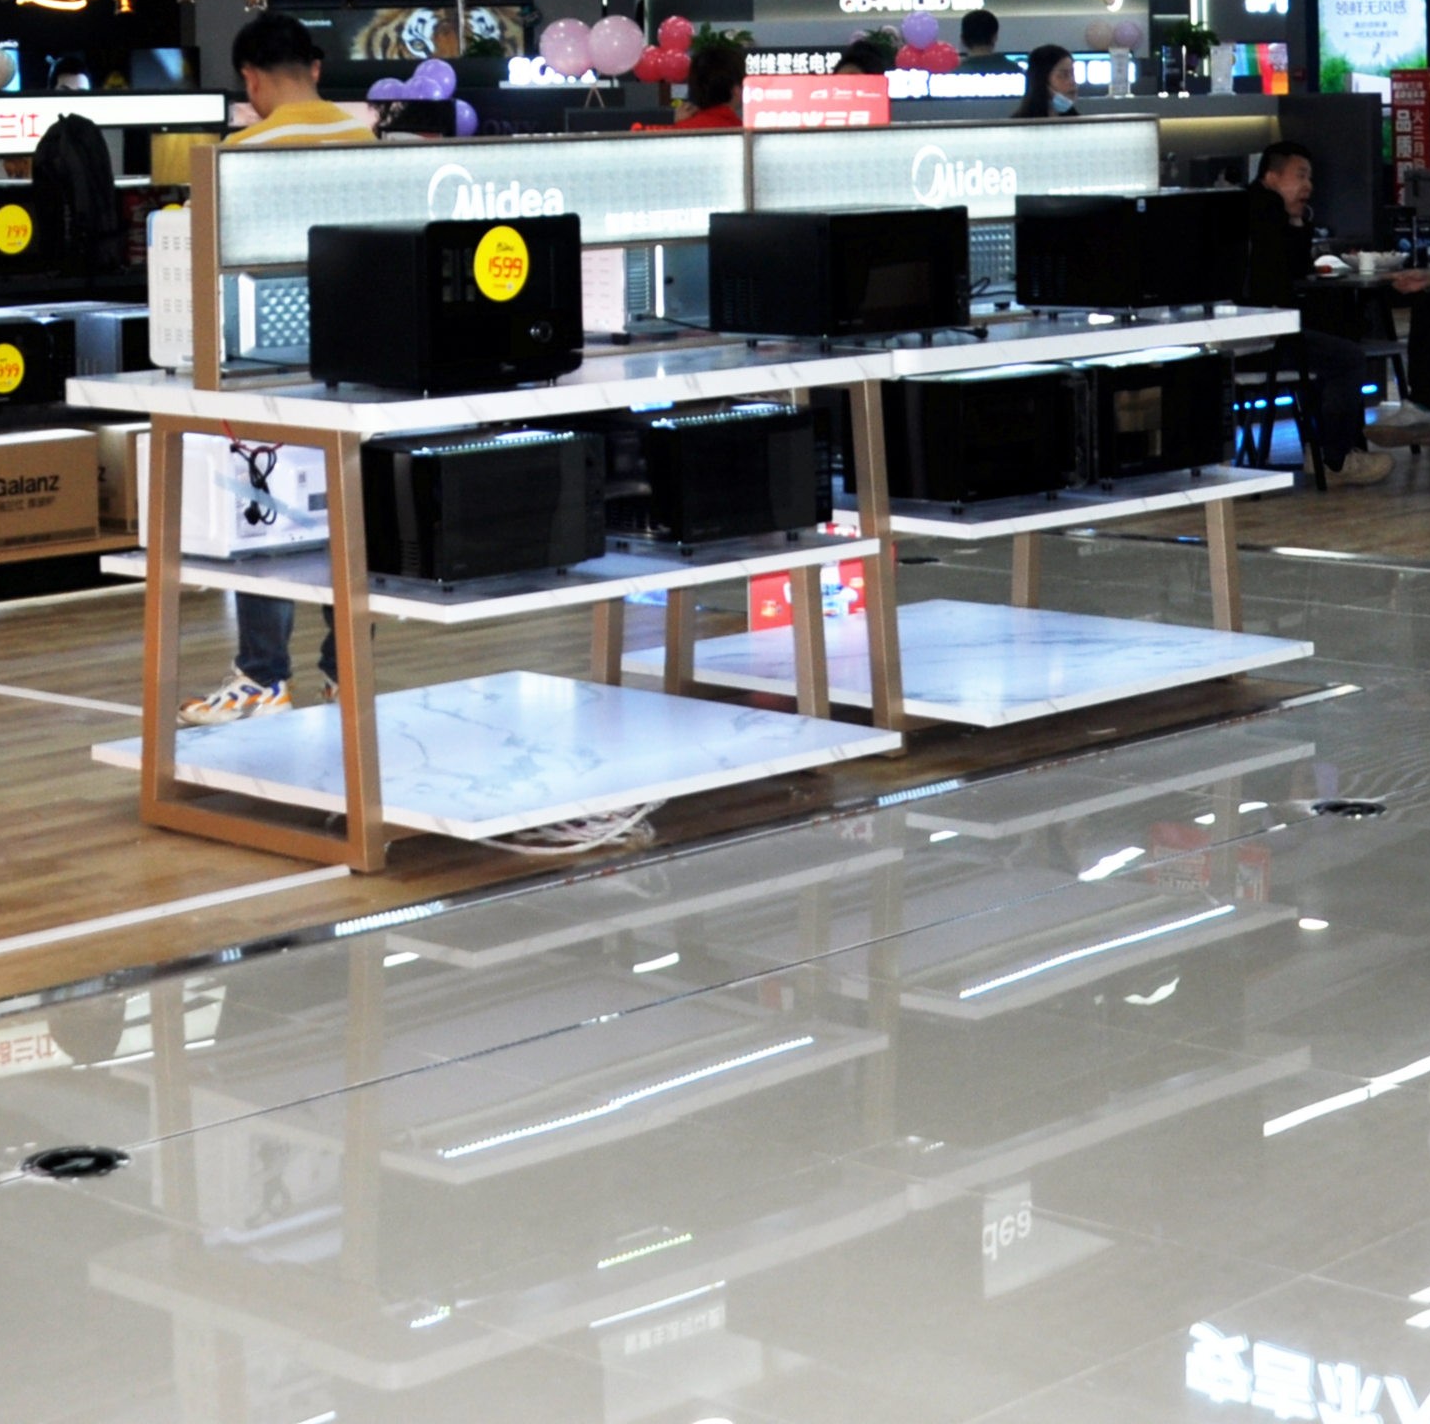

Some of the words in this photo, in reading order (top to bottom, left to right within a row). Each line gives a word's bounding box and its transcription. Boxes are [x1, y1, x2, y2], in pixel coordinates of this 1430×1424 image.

[931, 159, 1018, 198] Midea
[451, 180, 565, 221] Midea
[488, 256, 523, 279] 1599
